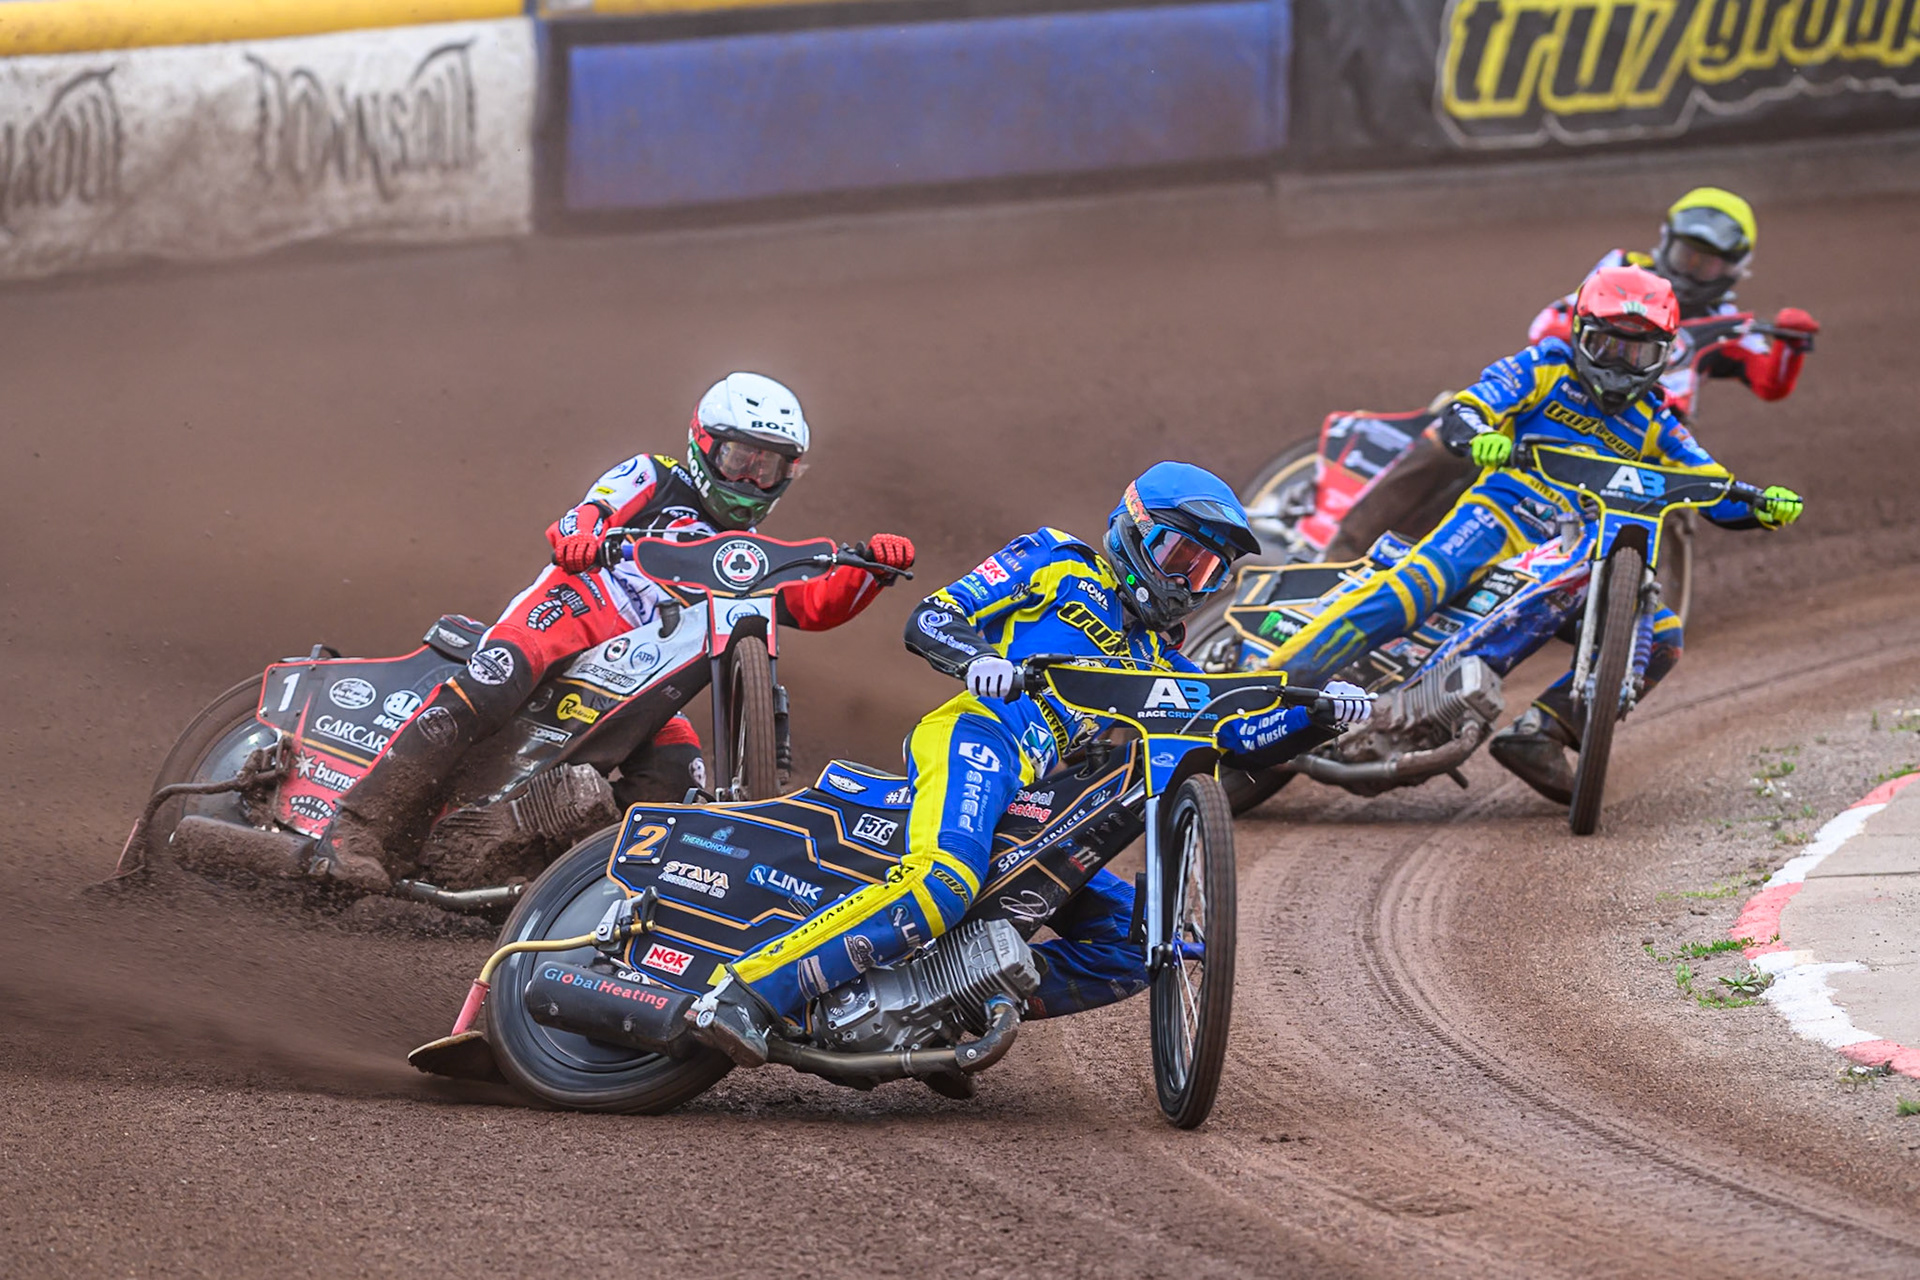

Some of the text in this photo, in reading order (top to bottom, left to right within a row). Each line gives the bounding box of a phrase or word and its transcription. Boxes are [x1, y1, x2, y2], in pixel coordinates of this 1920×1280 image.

[1606, 465, 1666, 497] AB
[1242, 574, 1272, 604] 1
[538, 606, 564, 632] POINT
[278, 673, 300, 712] 1
[1143, 678, 1211, 710] AB
[1137, 710, 1167, 719] RACE
[1257, 724, 1288, 747] Music
[290, 796, 333, 818] EASTERN
[292, 805, 324, 820] POINT
[958, 770, 983, 833] PBHS
[1008, 803, 1052, 823] eating
[625, 822, 670, 859] 2
[682, 834, 734, 855] THERMOHOME
[663, 860, 729, 889] STAVA
[768, 869, 823, 900] LINK
[791, 893, 864, 942] SERVICES
[649, 946, 689, 968] NGK
